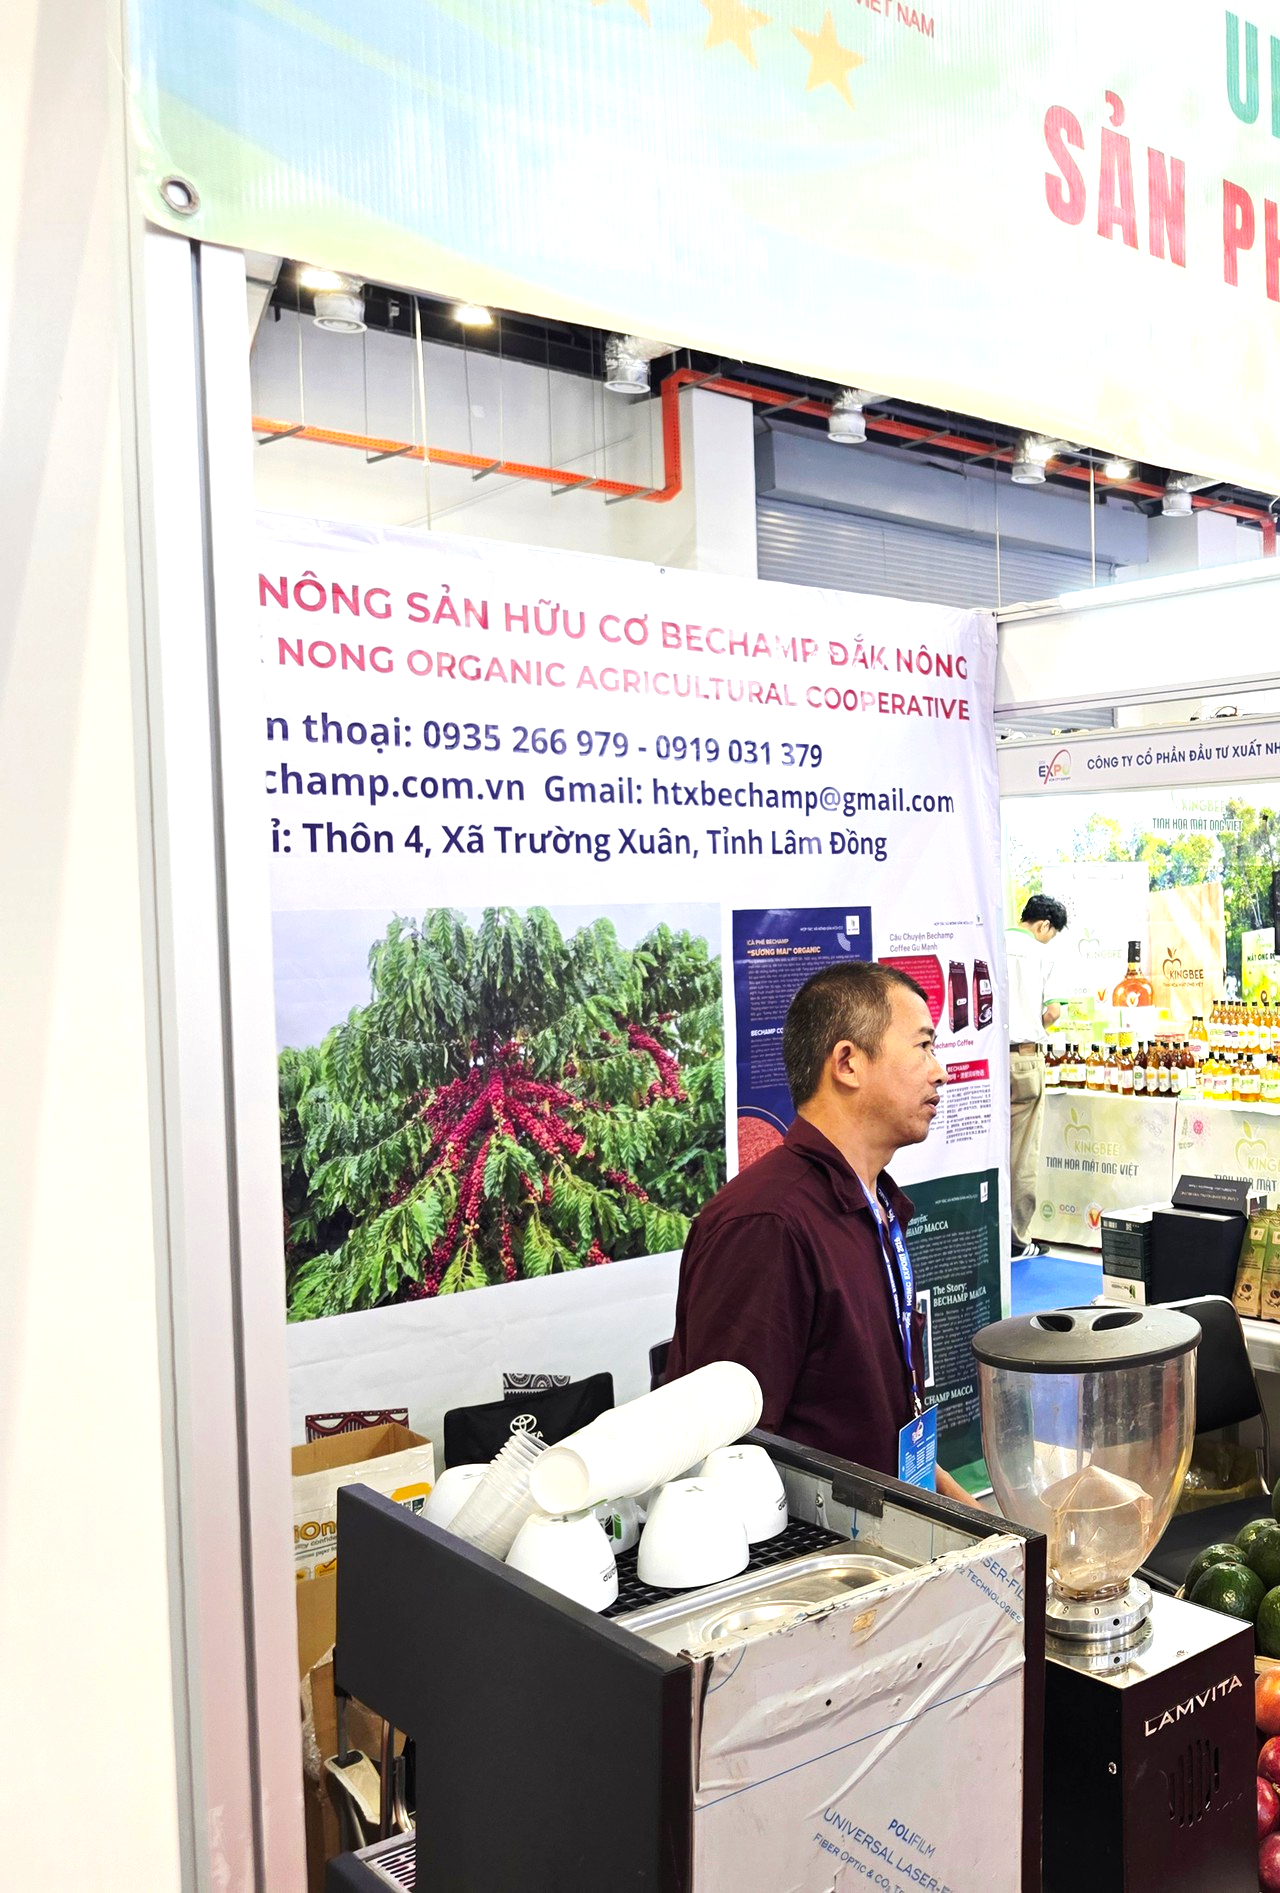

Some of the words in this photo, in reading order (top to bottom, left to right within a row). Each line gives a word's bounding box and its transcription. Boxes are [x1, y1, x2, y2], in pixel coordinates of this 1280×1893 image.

[898, 2, 934, 38] NAM
[1044, 90, 1187, 268] SẢN
[258, 570, 393, 620] NÔNG
[407, 584, 489, 630] SẢN
[505, 598, 586, 640] HỮU
[599, 614, 649, 646] CƠ
[662, 621, 819, 662] BECHAMP
[828, 633, 890, 671] ĐẮK
[896, 645, 968, 680] NÔNG
[278, 637, 394, 674] NONG
[407, 649, 566, 688] ORGANIC
[576, 665, 798, 708] AGRICULTURAL
[806, 685, 970, 721] COOPERATIVE
[302, 712, 412, 754] thoại:
[424, 720, 501, 752] 0935
[512, 726, 568, 756] 266
[576, 730, 630, 758] 979
[656, 734, 720, 763] 0919
[729, 739, 772, 767] 031
[781, 742, 824, 768] 379
[1087, 755, 1119, 771] CÔNG
[1122, 756, 1134, 768] TY
[1136, 747, 1153, 766] CỔ
[1156, 745, 1187, 764] PHẦN
[1189, 743, 1213, 761] ĐẦU
[1216, 744, 1231, 760] TƯ
[1232, 738, 1263, 758] XUẤT
[265, 762, 525, 806] champ.com.vn
[544, 774, 642, 804] Gmail:
[653, 777, 955, 818] htxbechamp@gmail.com
[302, 822, 394, 853] Thôn
[404, 824, 432, 859] 4,
[442, 823, 485, 854] Xã
[494, 825, 612, 862] Trường
[618, 827, 700, 860] Xuân,
[706, 826, 764, 857] Tỉnh
[772, 829, 823, 857] Lâm
[829, 828, 888, 862] Đồng
[793, 946, 821, 954] ORGANIC
[889, 944, 911, 952] Coffee
[927, 932, 954, 941] Bechamp
[1169, 968, 1204, 980] KINGBEE
[957, 1039, 974, 1047] Coffee
[1046, 1156, 1062, 1169] TINH
[1064, 1158, 1080, 1170] HOA
[1101, 1162, 1117, 1175] ONG
[1074, 1140, 1119, 1156] KINGBEE
[924, 1220, 949, 1233] MACCA
[933, 1286, 945, 1296] The
[946, 1282, 968, 1295] Story:
[933, 1293, 969, 1307] BECHAMP
[967, 1569, 1023, 1624] TECHNOLOGIES
[1143, 1674, 1243, 1737] LAMVITA
[813, 1833, 840, 1856] FIBER
[840, 1851, 867, 1873] OPTIC
[823, 1807, 894, 1865] UNIVERSAL
[888, 1818, 937, 1859] POLIFILM
